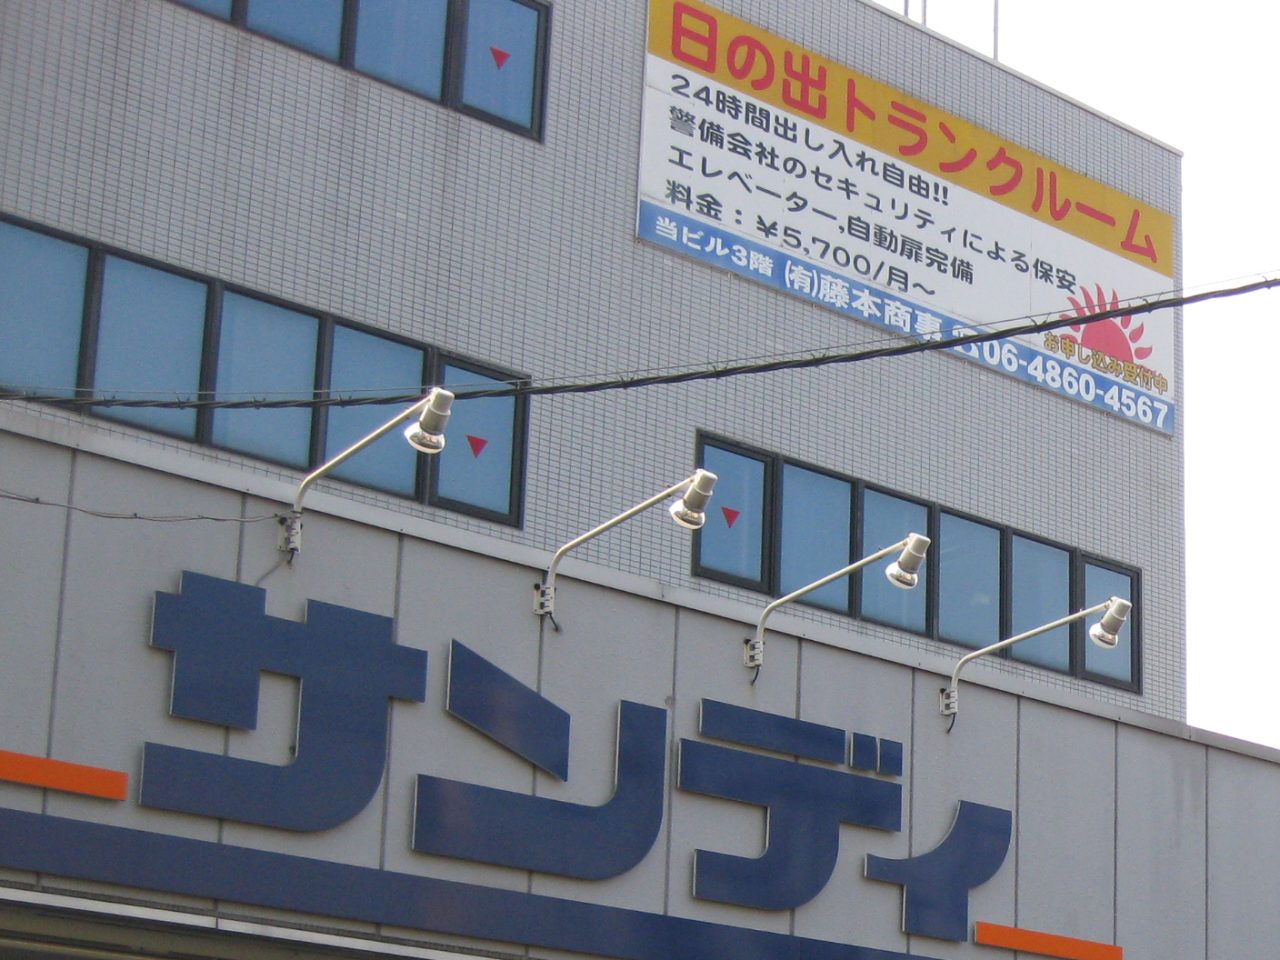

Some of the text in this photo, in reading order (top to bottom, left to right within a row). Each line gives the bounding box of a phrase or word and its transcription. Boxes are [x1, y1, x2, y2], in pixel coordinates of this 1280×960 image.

[669, 105, 1077, 295] 警備会社のセキュリティによる保安
[671, 74, 950, 207] 24時間出し入れ自由!!
[672, 1, 1158, 264] 日の出トランクルーム
[656, 216, 774, 277] 当ビル3階
[1043, 332, 1168, 395] お申し込み受付中
[139, 569, 1011, 941] サンディ
